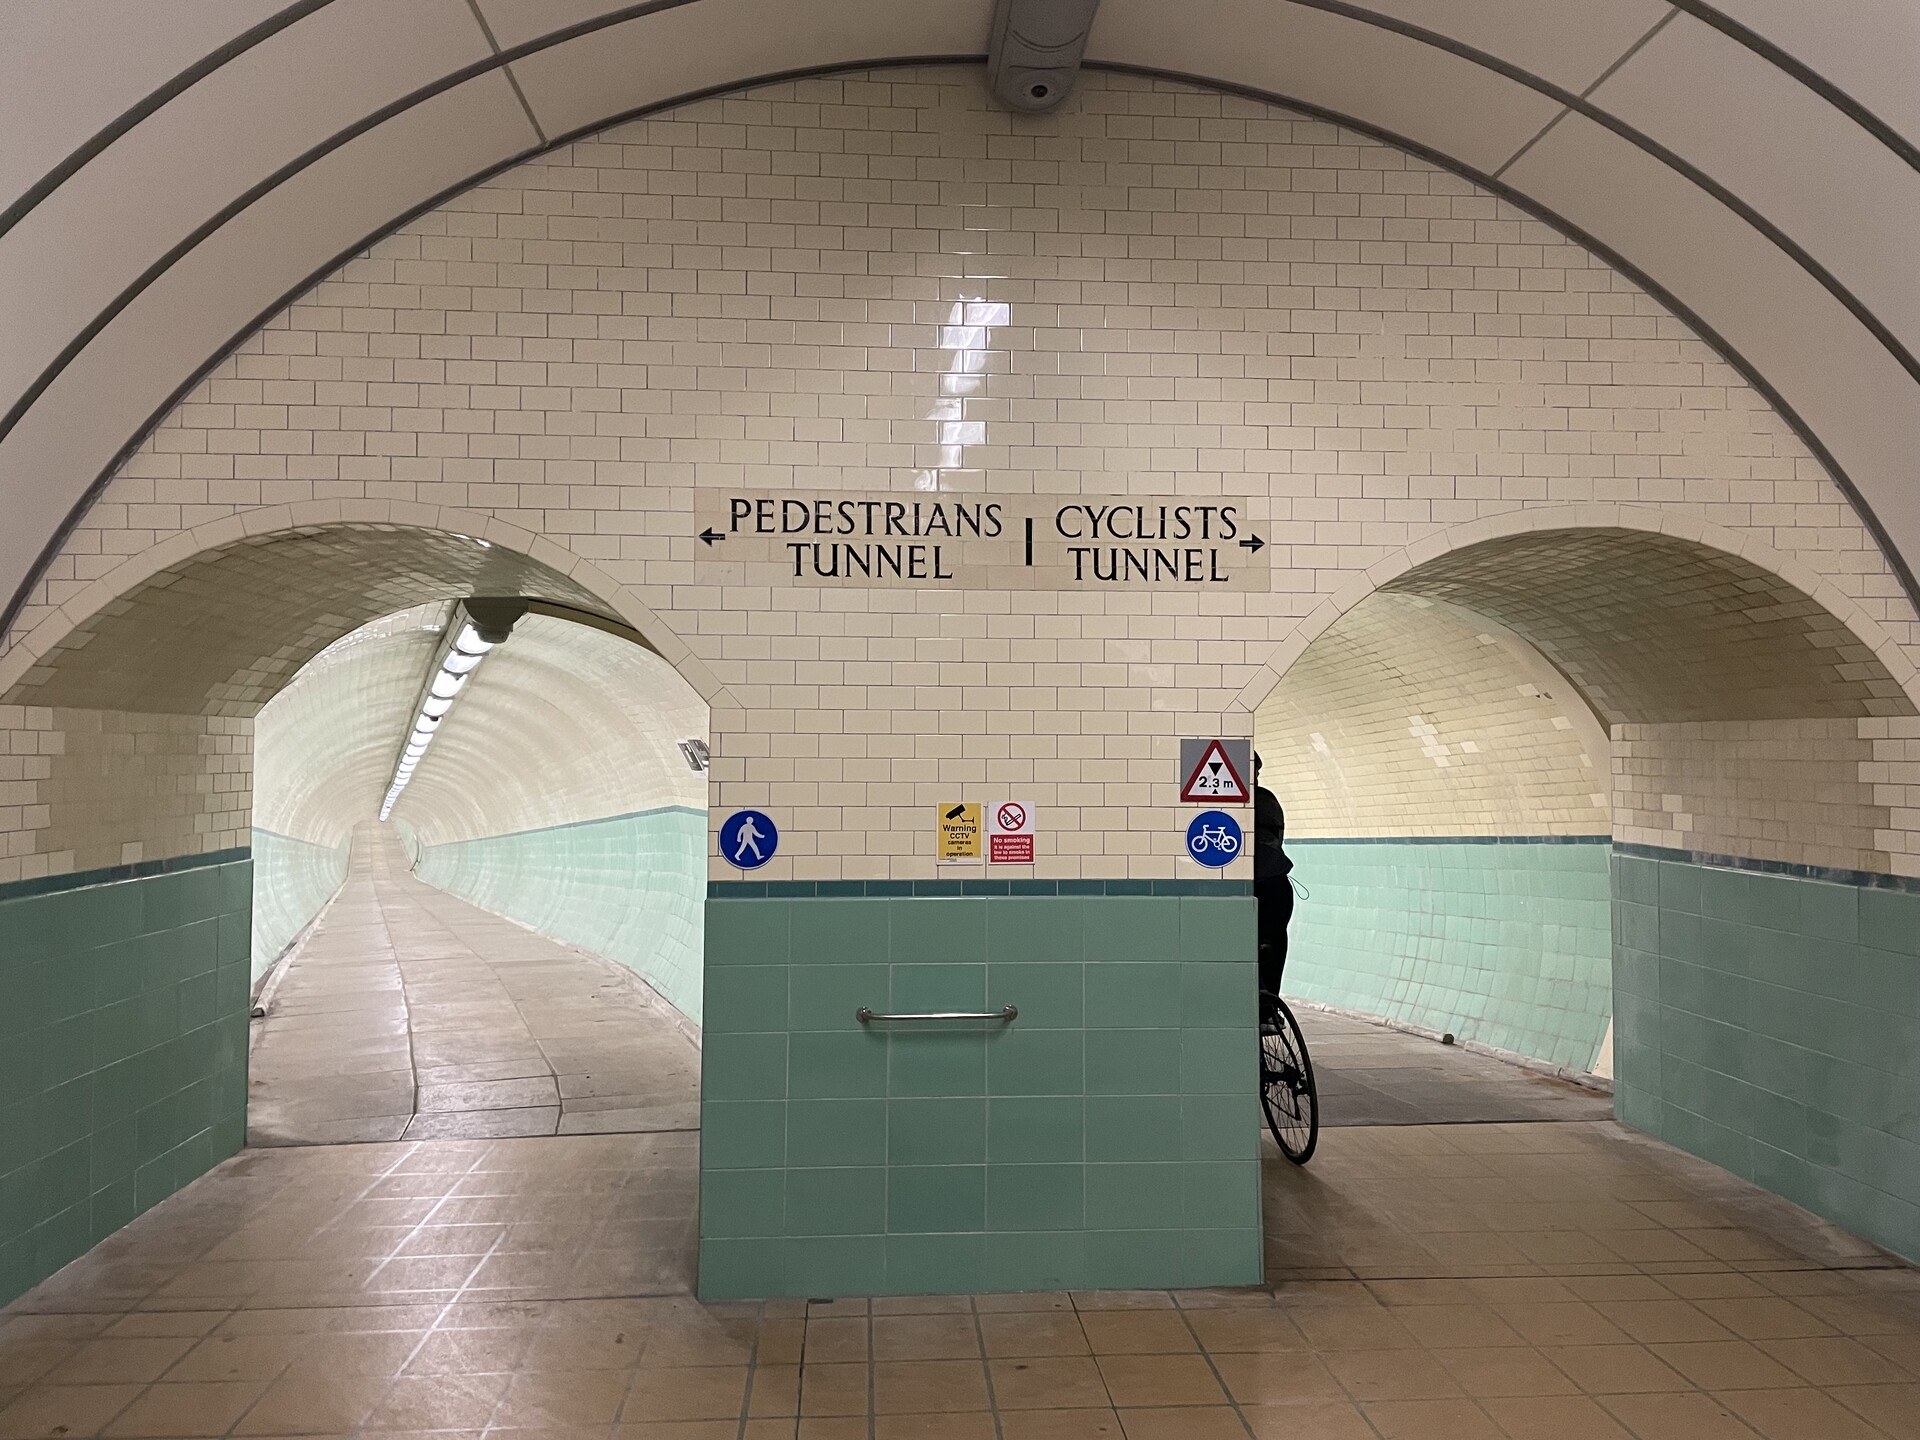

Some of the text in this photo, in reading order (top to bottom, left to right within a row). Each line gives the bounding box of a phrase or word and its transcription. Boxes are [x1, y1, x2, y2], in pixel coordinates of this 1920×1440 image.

[731, 498, 1002, 538] PEDESTRIANS
[1056, 505, 1238, 540] CYCLISTS
[786, 543, 953, 579] TUNNEL
[1066, 547, 1230, 582] TUNNEL
[1199, 776, 1234, 788] 2.3 m
[943, 824, 977, 833] Warning
[1003, 836, 1031, 845] smoking
